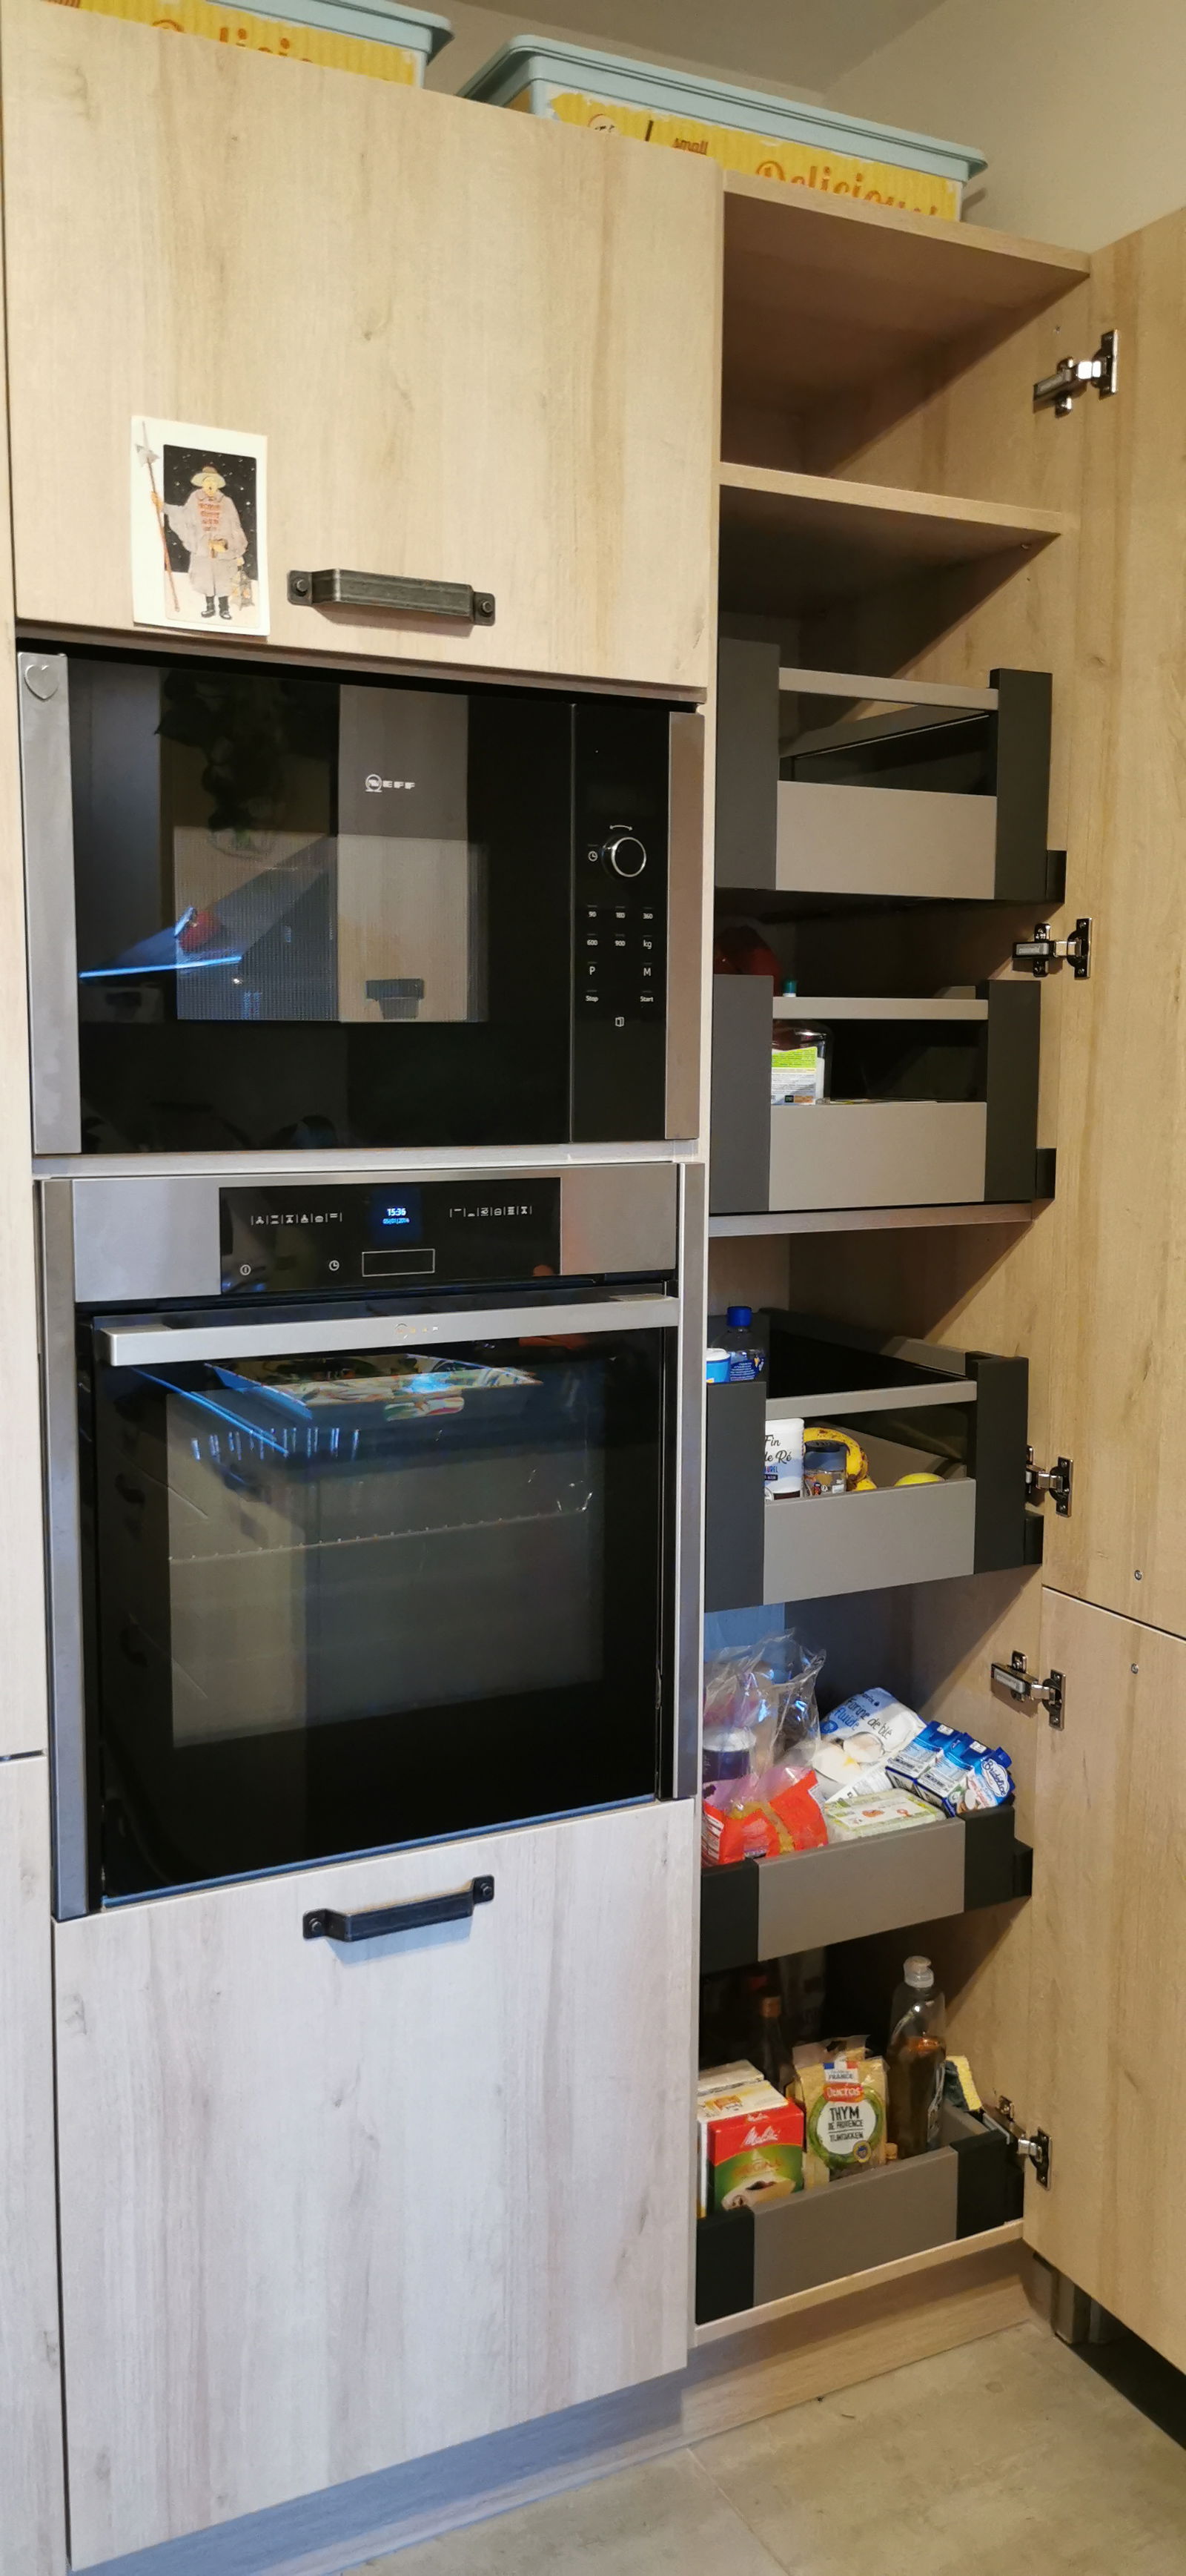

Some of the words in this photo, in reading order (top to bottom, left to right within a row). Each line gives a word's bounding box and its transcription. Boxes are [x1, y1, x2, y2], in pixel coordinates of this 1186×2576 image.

[643, 939, 652, 949] kg
[589, 966, 595, 975] P
[643, 968, 651, 976] M
[775, 1450, 792, 1464] Ré
[846, 1697, 870, 1720] Farine
[867, 1718, 880, 1730] de
[829, 2106, 859, 2121] THYM
[836, 2119, 864, 2128] PROVENCE
